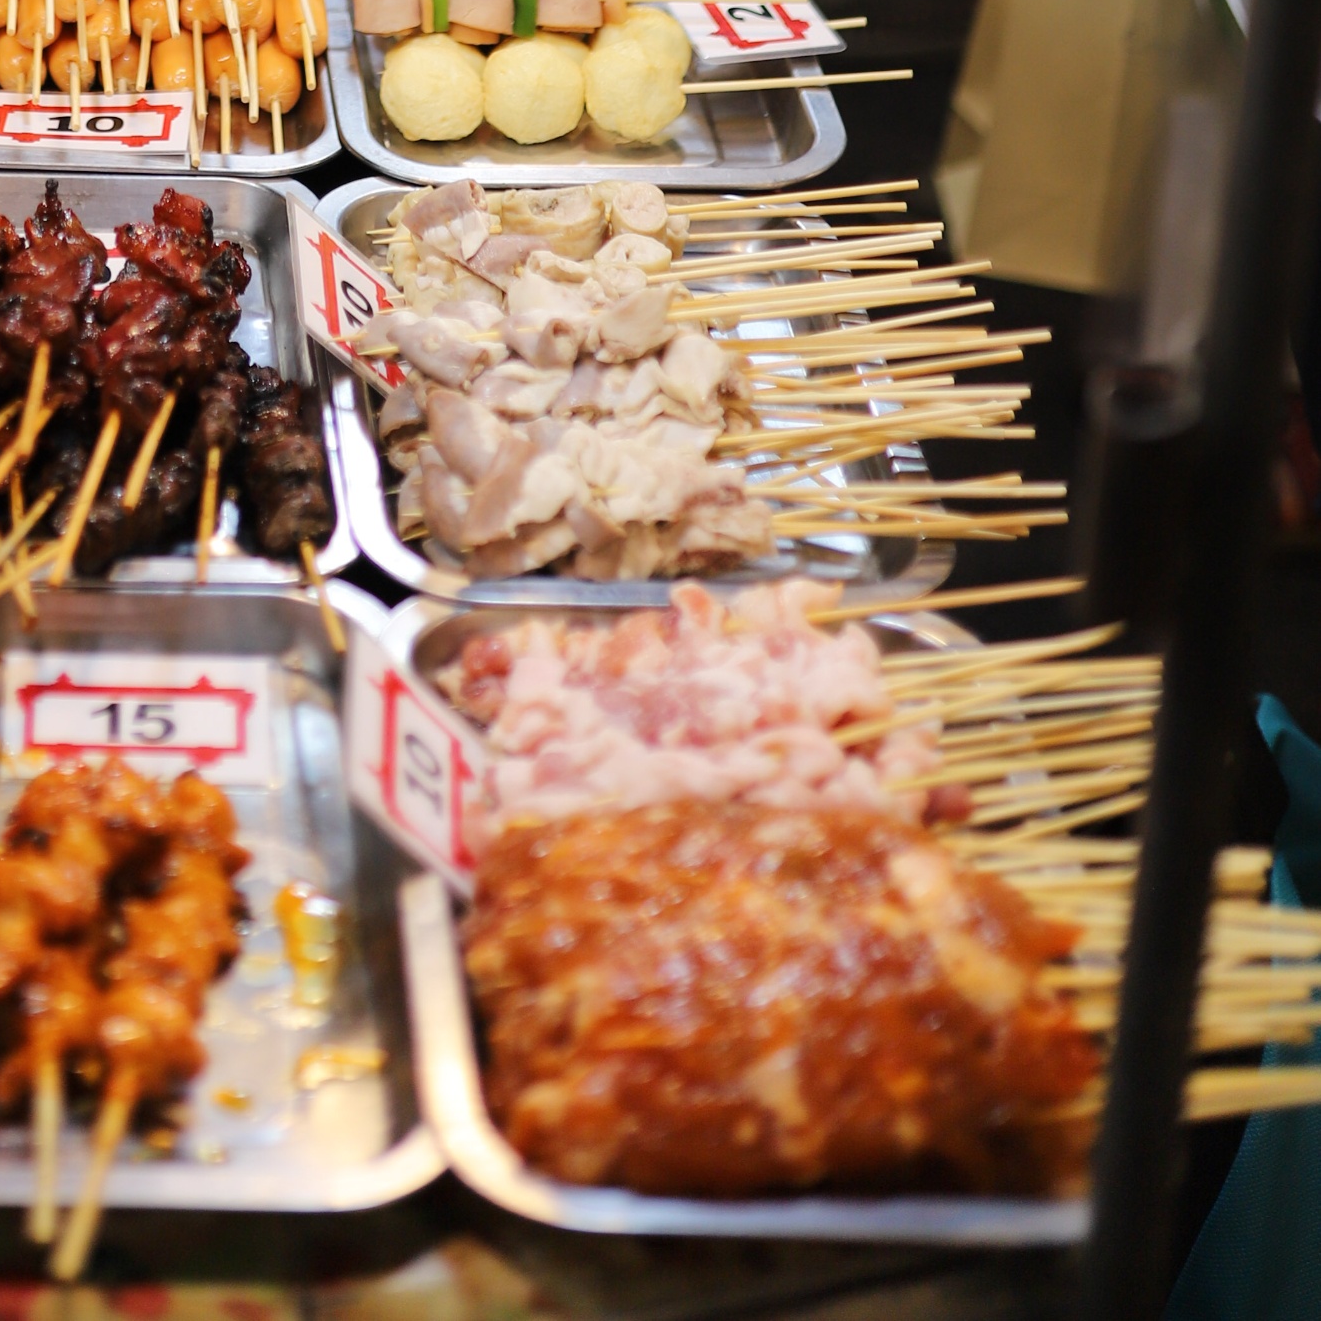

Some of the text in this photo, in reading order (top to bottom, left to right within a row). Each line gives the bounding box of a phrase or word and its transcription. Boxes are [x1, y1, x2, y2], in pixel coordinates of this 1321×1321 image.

[47, 115, 124, 133] 10
[90, 702, 177, 745] 15
[404, 733, 442, 819] 10
